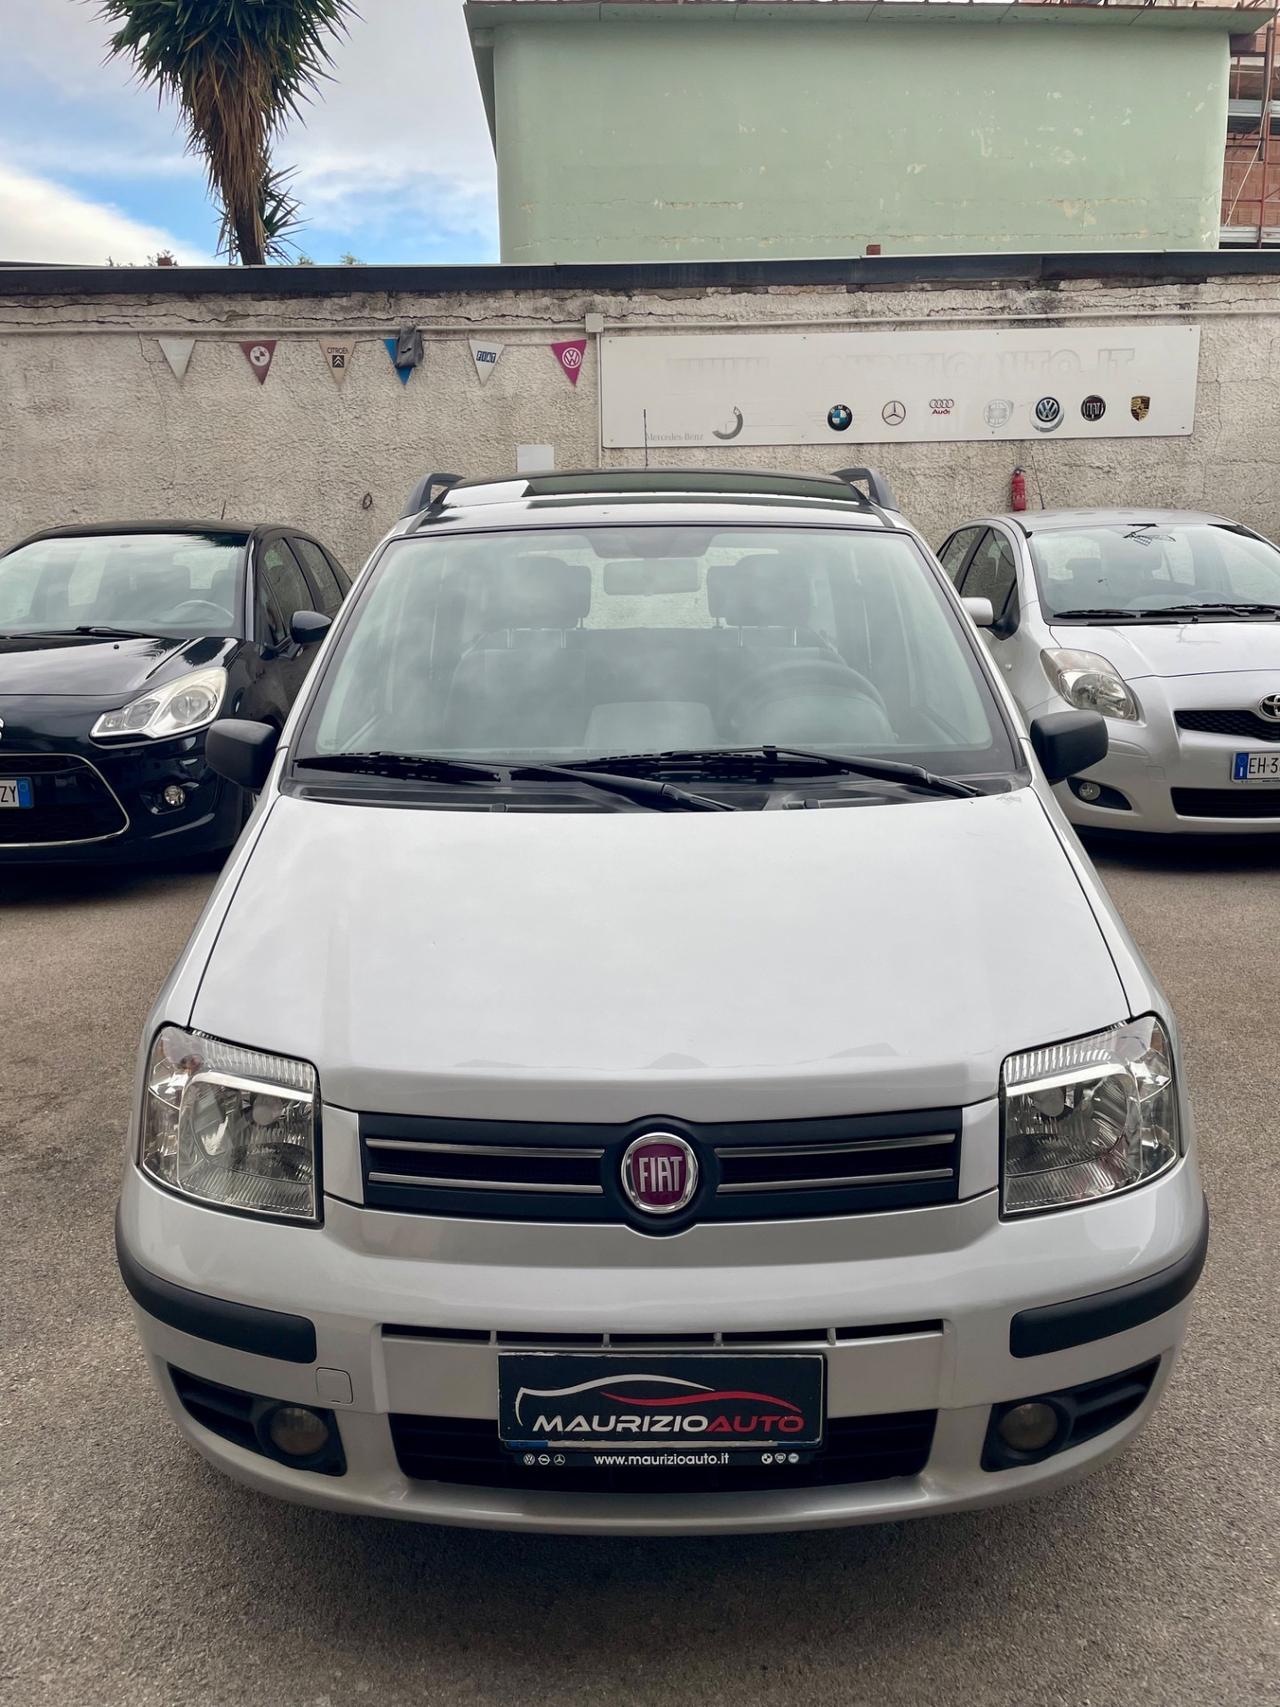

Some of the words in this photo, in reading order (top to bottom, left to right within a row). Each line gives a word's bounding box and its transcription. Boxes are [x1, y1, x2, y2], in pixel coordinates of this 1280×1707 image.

[476, 350, 496, 363] FIAT
[638, 1156, 683, 1193] FIAT
[594, 1452, 729, 1466] www.maurizioauto.it
